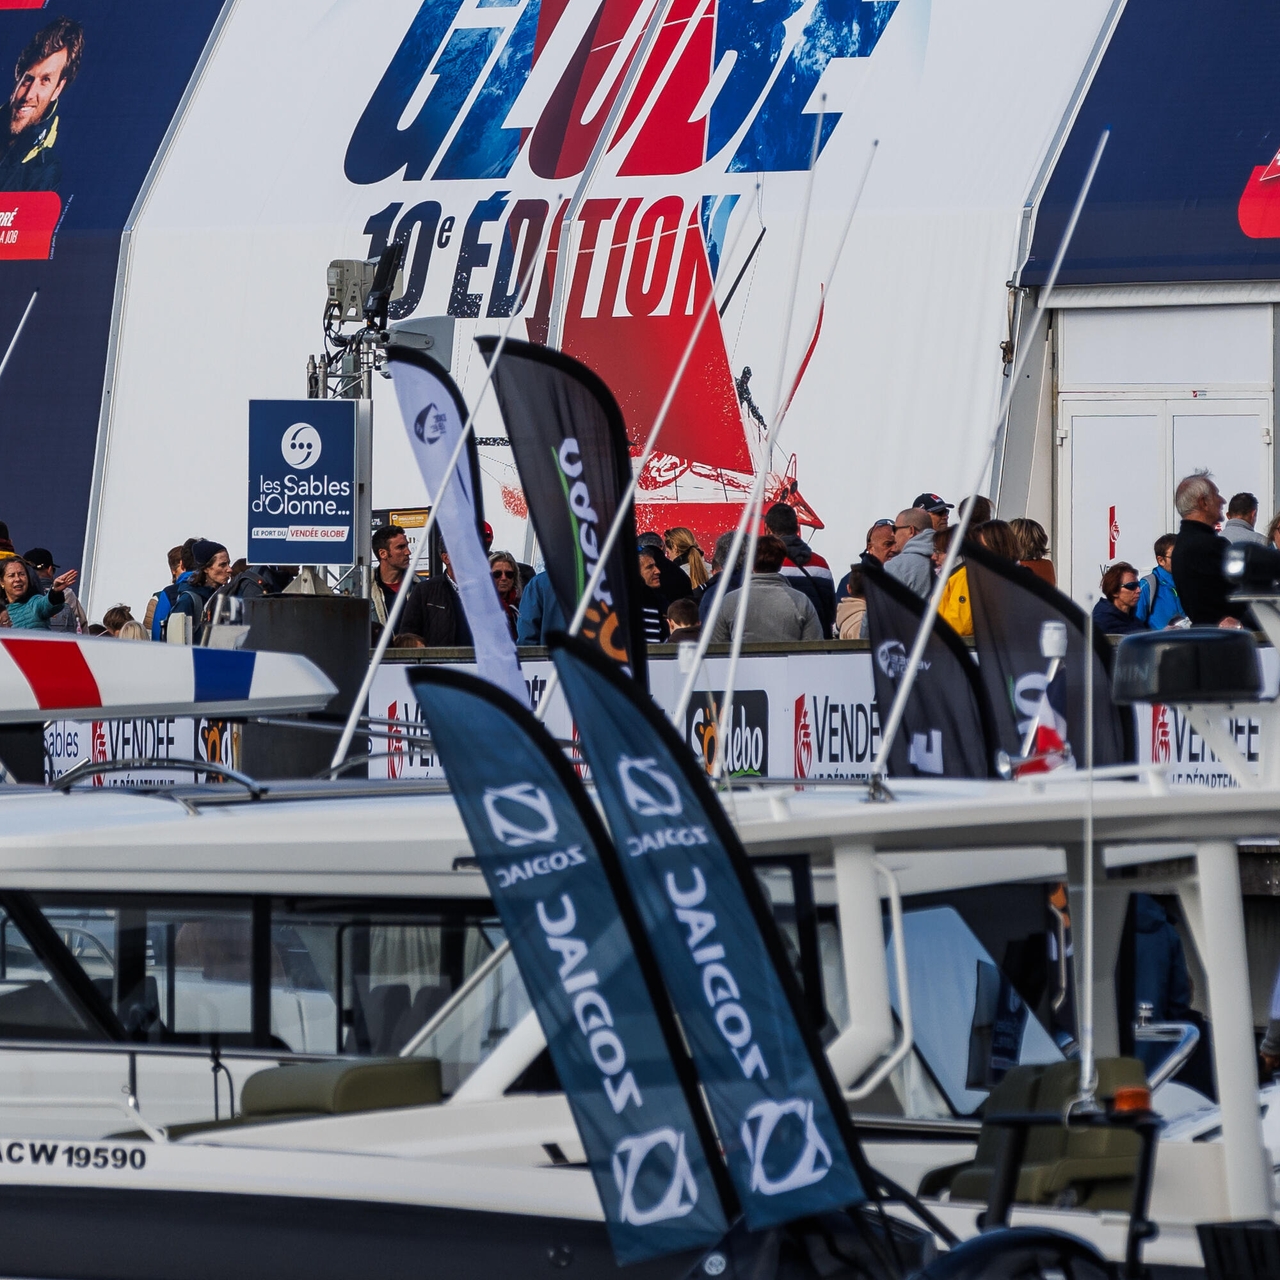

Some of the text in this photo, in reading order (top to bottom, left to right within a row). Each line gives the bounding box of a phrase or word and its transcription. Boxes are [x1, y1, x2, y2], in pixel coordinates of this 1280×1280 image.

[0, 231, 5, 244] A
[4, 230, 19, 244] JOB
[448, 191, 742, 319] ÉDITION
[260, 474, 350, 496] les Sables
[251, 494, 350, 515] d'Olonne...
[290, 527, 318, 537] VENDÉE
[320, 530, 345, 538] GLOBE
